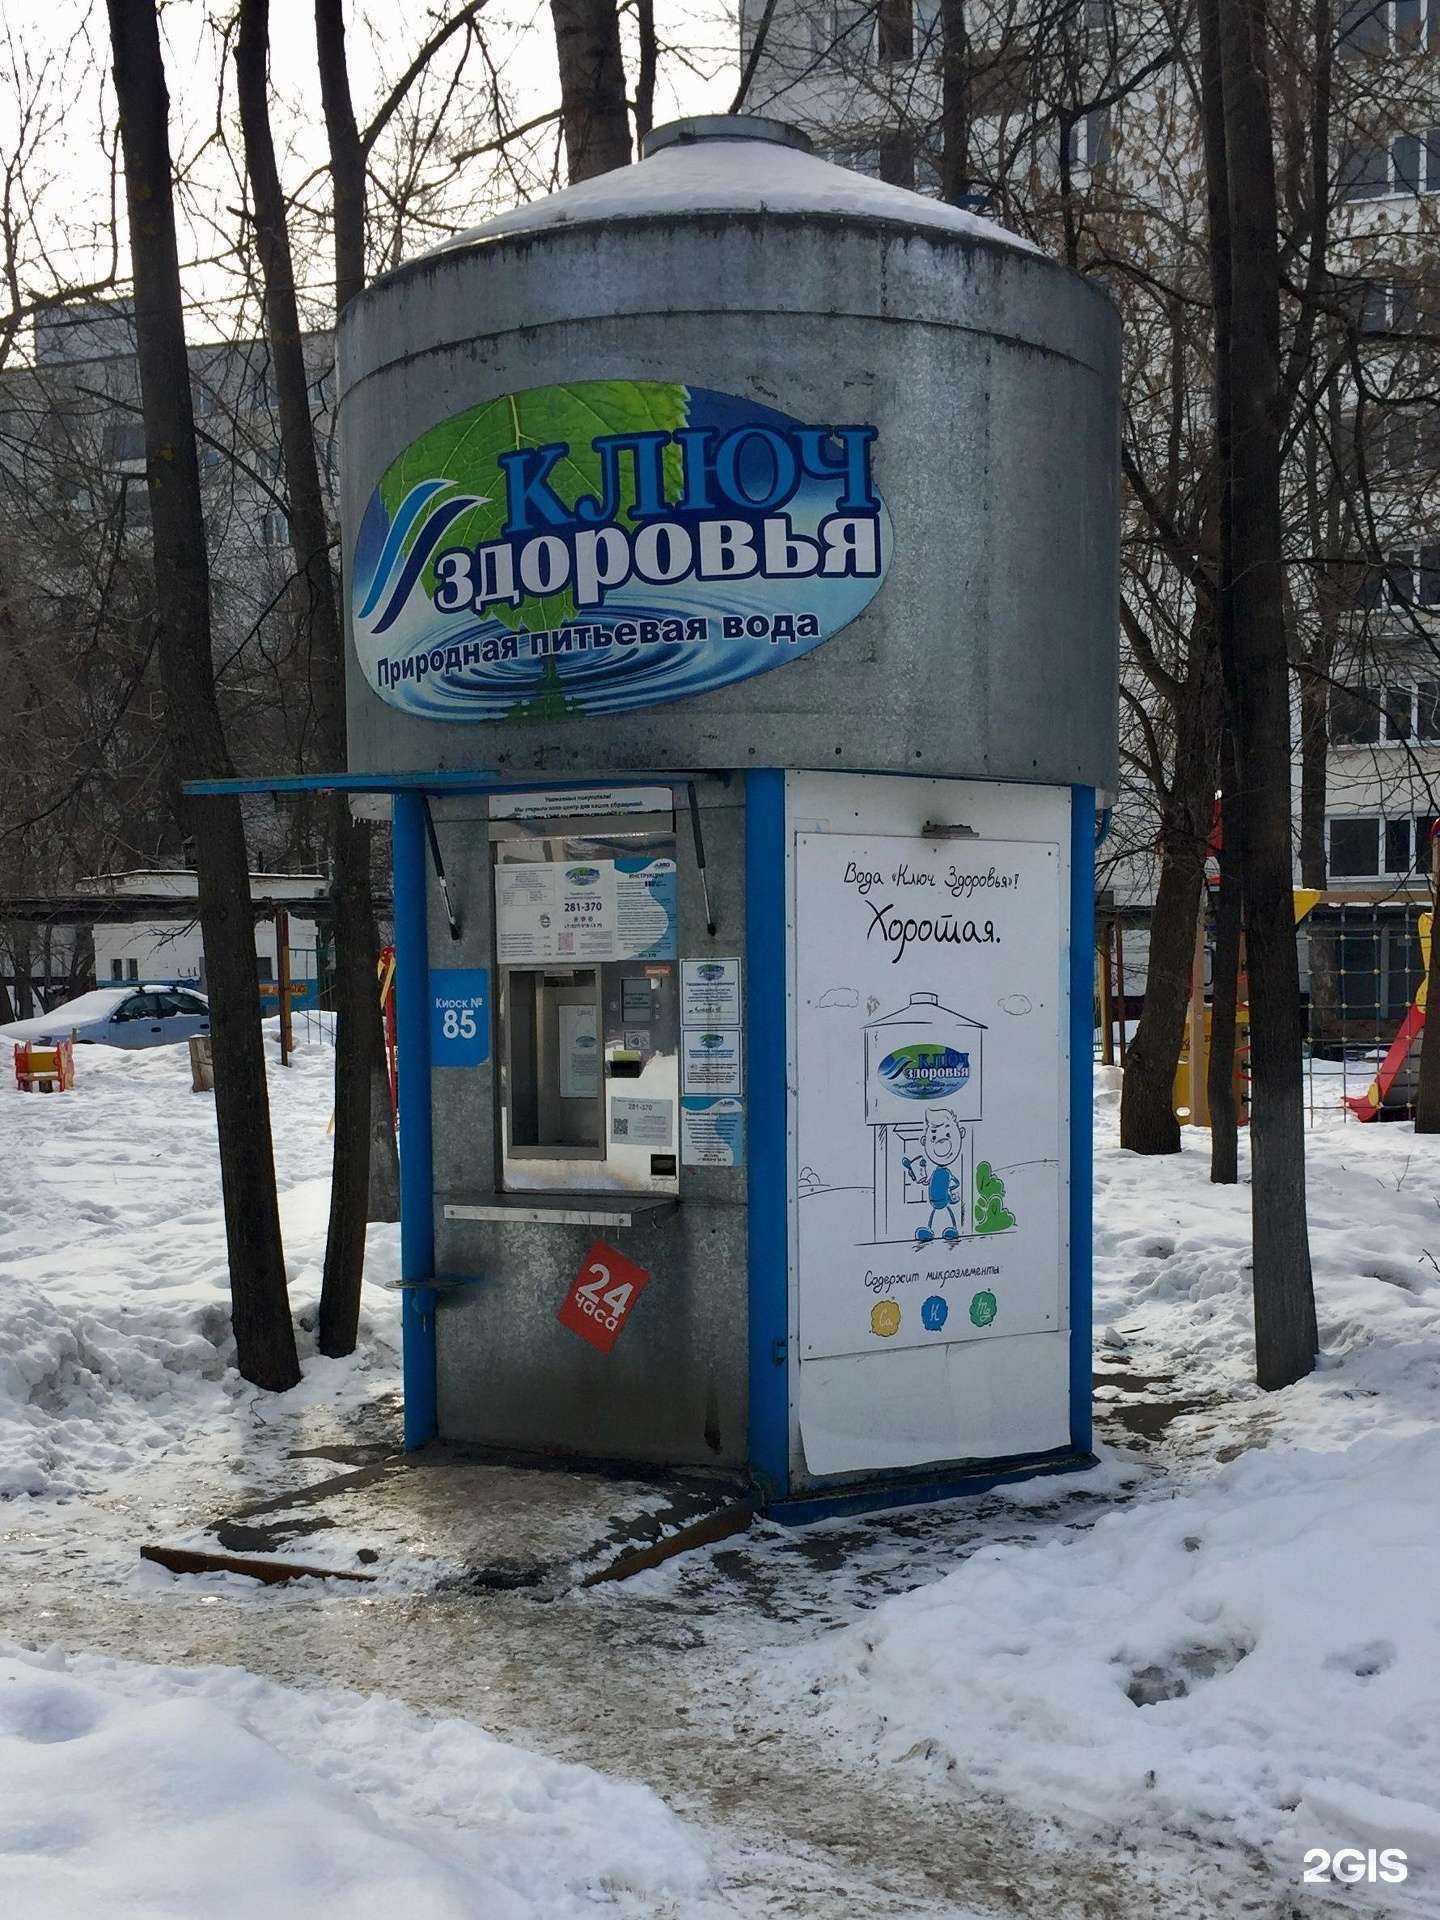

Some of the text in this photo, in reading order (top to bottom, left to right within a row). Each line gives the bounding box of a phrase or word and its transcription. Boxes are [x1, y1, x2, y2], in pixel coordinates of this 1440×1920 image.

[498, 423, 881, 536] КЛЮЧ
[377, 612, 820, 689] Природная питьевая вода
[844, 862, 884, 894] Вода
[892, 864, 936, 887] «Ключ
[564, 902, 602, 912] 281-370
[864, 900, 1001, 963] Хорошая.
[435, 997, 468, 1009] Киоск
[442, 1009, 477, 1039] 85
[577, 1263, 634, 1318] 24
[864, 1270, 920, 1294] Содержит
[576, 1291, 619, 1331] часа
